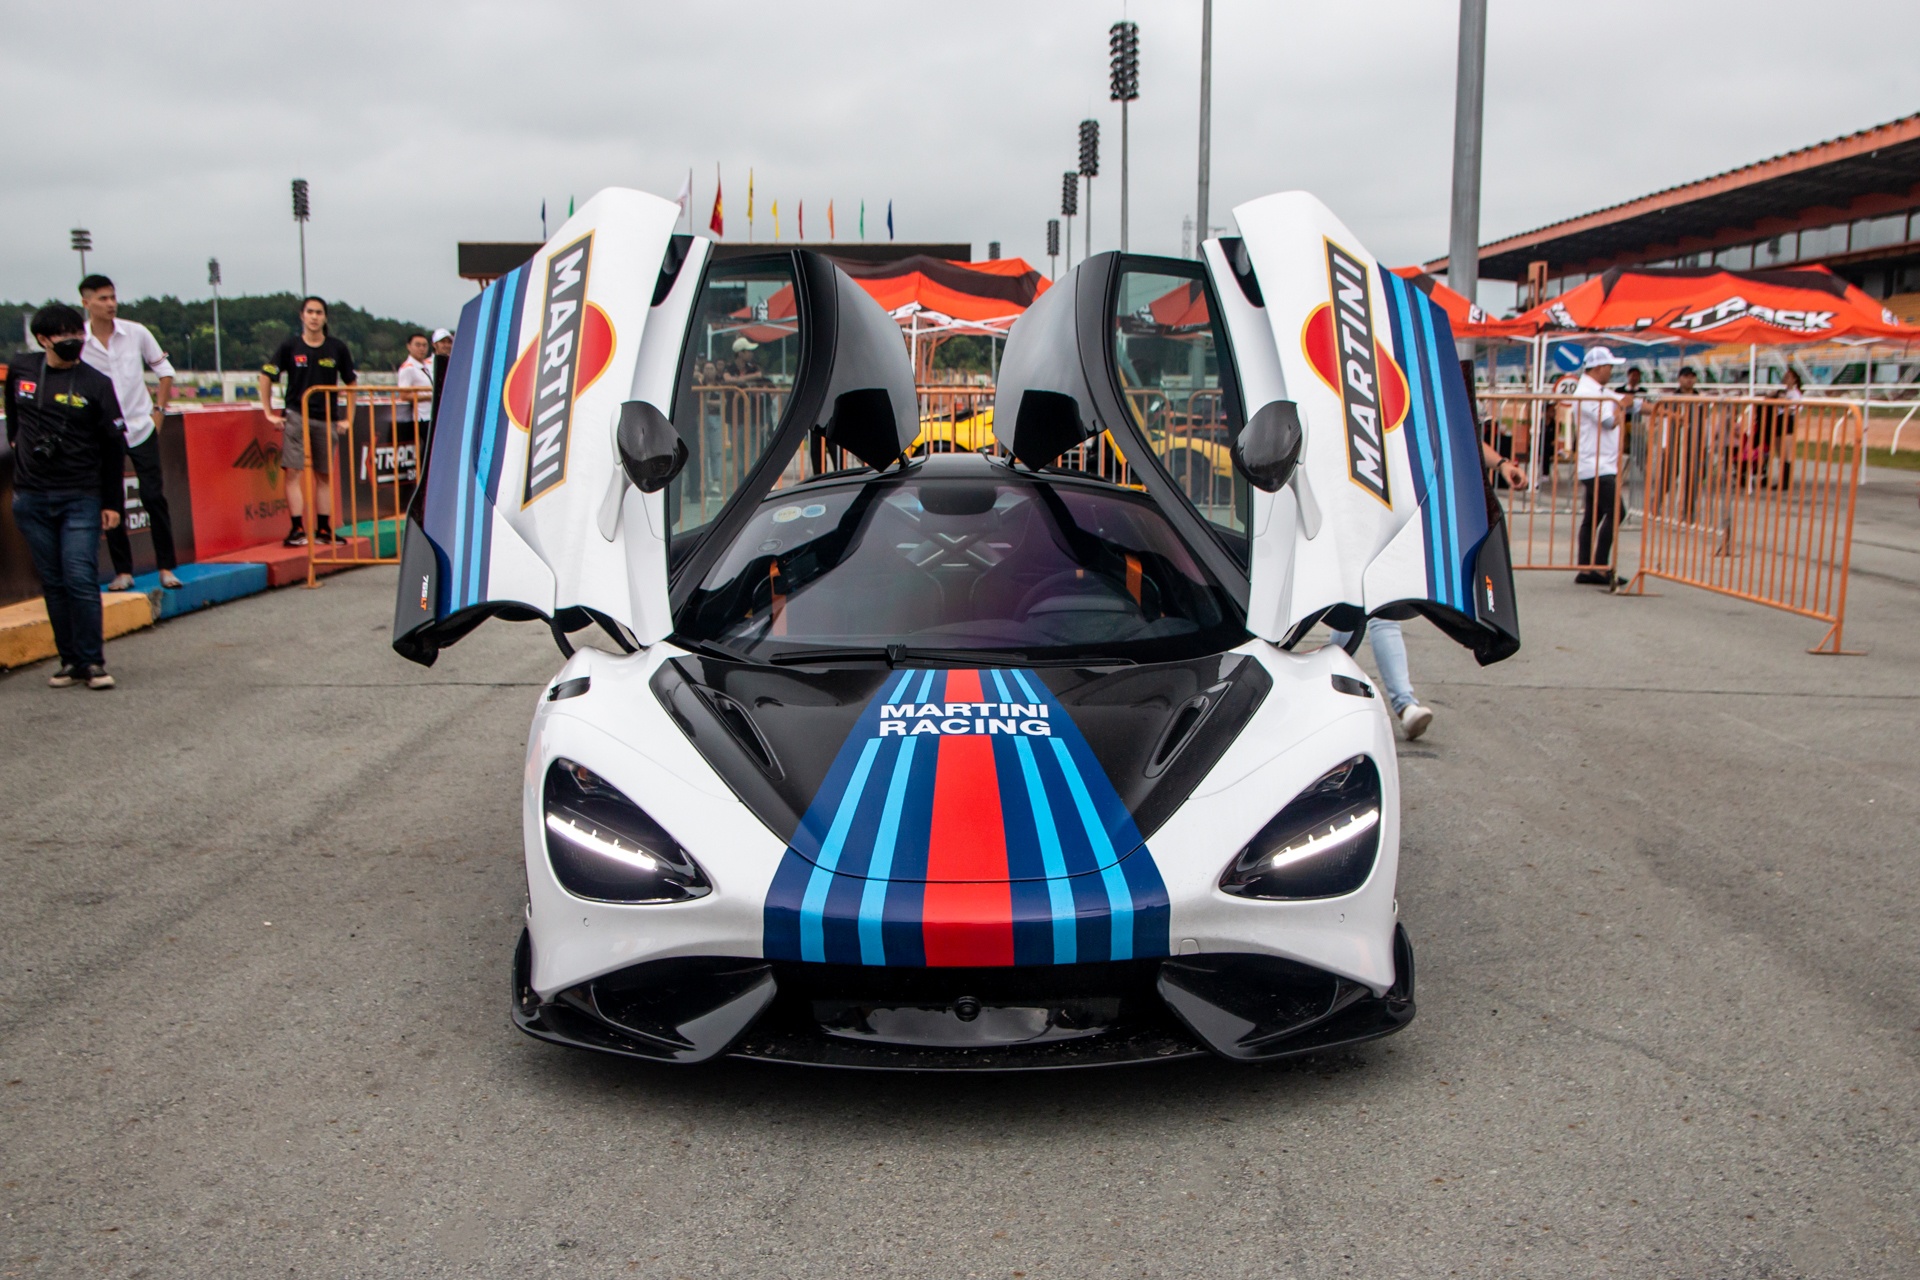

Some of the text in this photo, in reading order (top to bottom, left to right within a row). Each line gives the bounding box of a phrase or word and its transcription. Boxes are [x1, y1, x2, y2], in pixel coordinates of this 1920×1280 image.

[531, 248, 583, 488] MARTINI
[1334, 253, 1384, 490] MARTINI
[1561, 382, 1577, 394] 20
[880, 703, 1049, 719] MARTINI
[879, 718, 1051, 737] RACING
